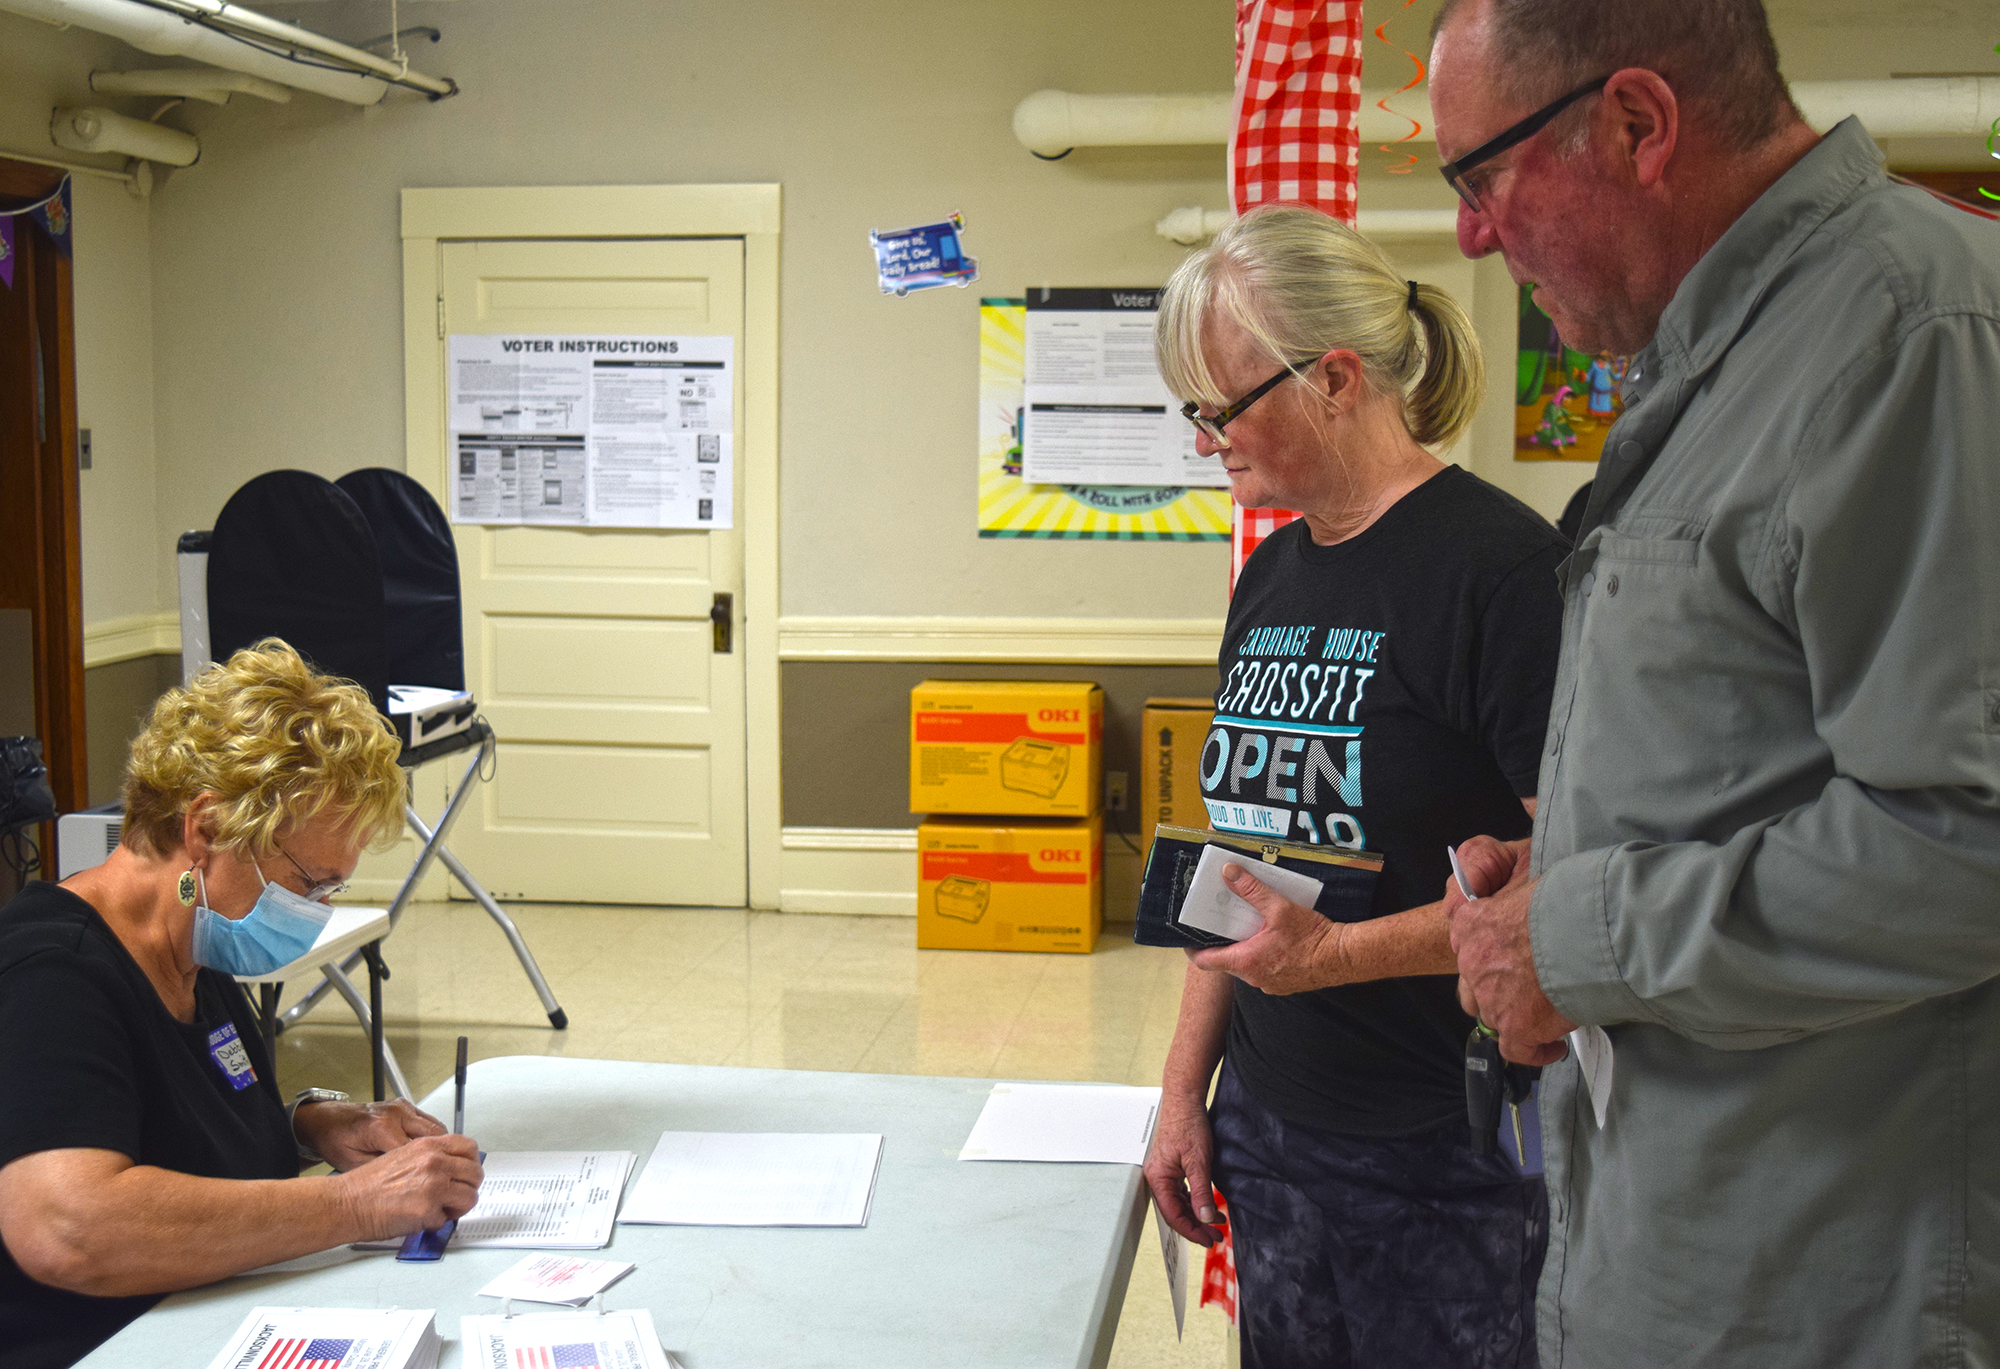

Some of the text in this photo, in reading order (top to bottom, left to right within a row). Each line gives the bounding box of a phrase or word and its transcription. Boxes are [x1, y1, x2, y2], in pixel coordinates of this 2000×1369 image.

[1112, 292, 1154, 307] Voter
[502, 340, 680, 354] VOTER INSTRUCTIONS
[1239, 626, 1386, 663] CARRIAGE HOUSE
[1217, 660, 1375, 722] CROSSFIT
[1038, 709, 1080, 723] OKI
[1200, 728, 1363, 807] OPEN
[1159, 806, 1173, 822] TO
[1233, 807, 1246, 826] TO
[1252, 809, 1280, 832] LIVE,
[1039, 848, 1081, 863] OKI
